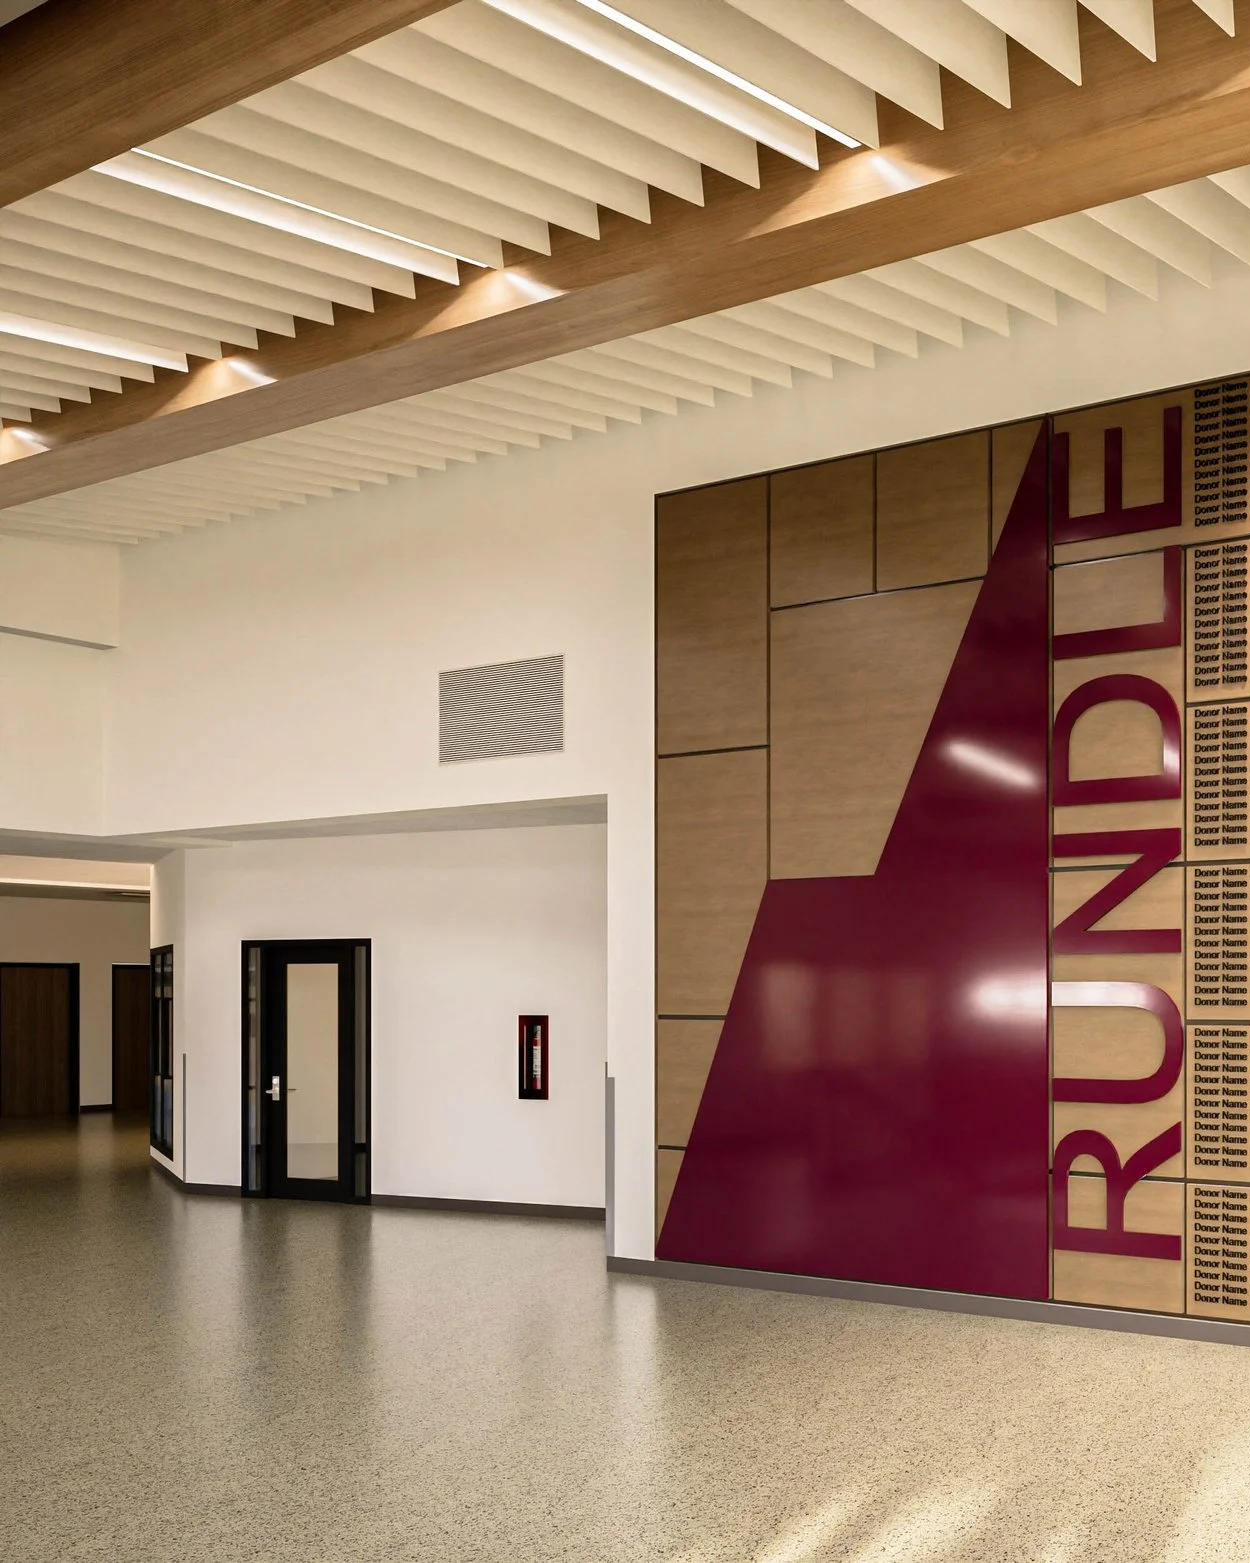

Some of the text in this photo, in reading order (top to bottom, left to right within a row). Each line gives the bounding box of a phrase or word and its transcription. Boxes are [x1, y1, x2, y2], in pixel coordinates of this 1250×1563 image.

[1194, 512, 1247, 528] Donor Name
[1194, 674, 1247, 687] Donor Name
[1194, 706, 1247, 718] Donor Name
[1052, 405, 1184, 1261] RUNDLE
[1194, 835, 1247, 847] Donor Name
[1194, 867, 1247, 878] Donor Name
[1194, 997, 1247, 1006] Donor Name
[1194, 1027, 1247, 1037] Donor Name
[1194, 1156, 1247, 1168] Donor Name
[1194, 1187, 1247, 1200] Donor Name
[1194, 1292, 1247, 1306] Donor Name
